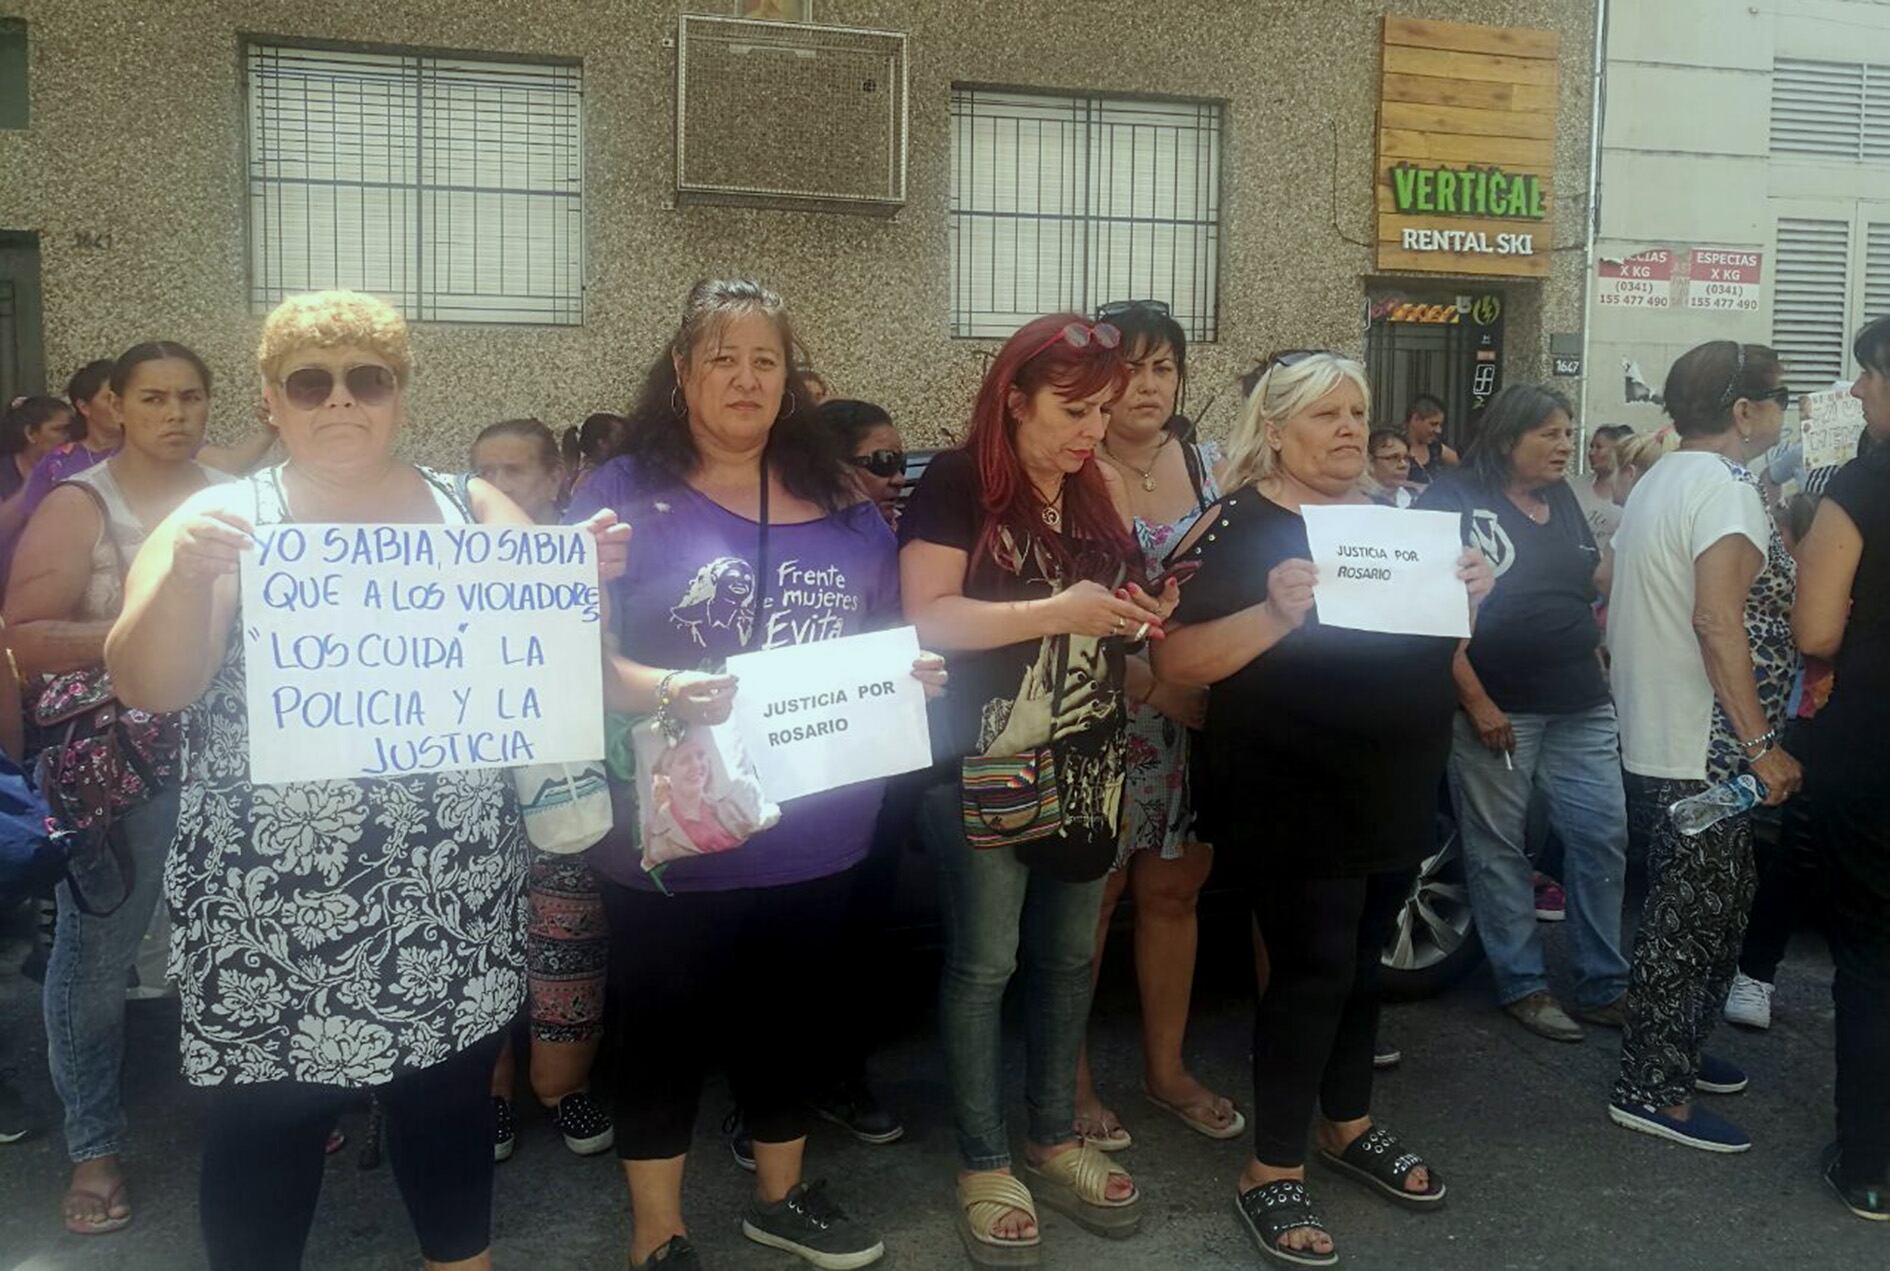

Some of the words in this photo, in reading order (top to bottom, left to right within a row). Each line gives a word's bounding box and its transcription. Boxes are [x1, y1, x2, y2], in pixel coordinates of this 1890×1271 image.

[1394, 167, 1546, 217] VERTICAL
[1402, 228, 1494, 254] RENTAL
[1496, 233, 1533, 255] SKI
[1620, 265, 1629, 277] X
[1632, 265, 1651, 278] KG
[1696, 252, 1757, 267] ESPECIAS
[1615, 281, 1653, 293] (0341)
[1711, 269, 1720, 280] X
[1723, 270, 1741, 281] KG
[1600, 294, 1619, 305] 155
[1623, 295, 1644, 306] 477
[1647, 296, 1668, 307] 490
[1691, 298, 1711, 307] 155
[1714, 299, 1735, 308] 477
[1737, 300, 1758, 310] 490
[1706, 284, 1743, 297] (0341)
[250, 529, 306, 566] YO
[444, 529, 491, 564] YO
[497, 529, 587, 565] SABIA
[1336, 546, 1387, 559] JUSTICIA
[1395, 550, 1420, 562] POR
[777, 559, 846, 588] Frente
[1336, 565, 1392, 581] ROSARIO
[263, 571, 343, 610] QUE
[363, 579, 382, 608] A
[391, 582, 445, 611] LOS
[782, 588, 859, 611] mujeres
[762, 609, 844, 650] Evita
[502, 635, 545, 666] LA
[271, 685, 425, 729] POLICIA
[453, 687, 471, 725] Y
[497, 687, 542, 721] LA
[763, 689, 848, 718] JUSTICIA
[858, 680, 896, 700] POR
[768, 717, 849, 747] ROSARIO
[361, 730, 535, 774] JUSTICIA
